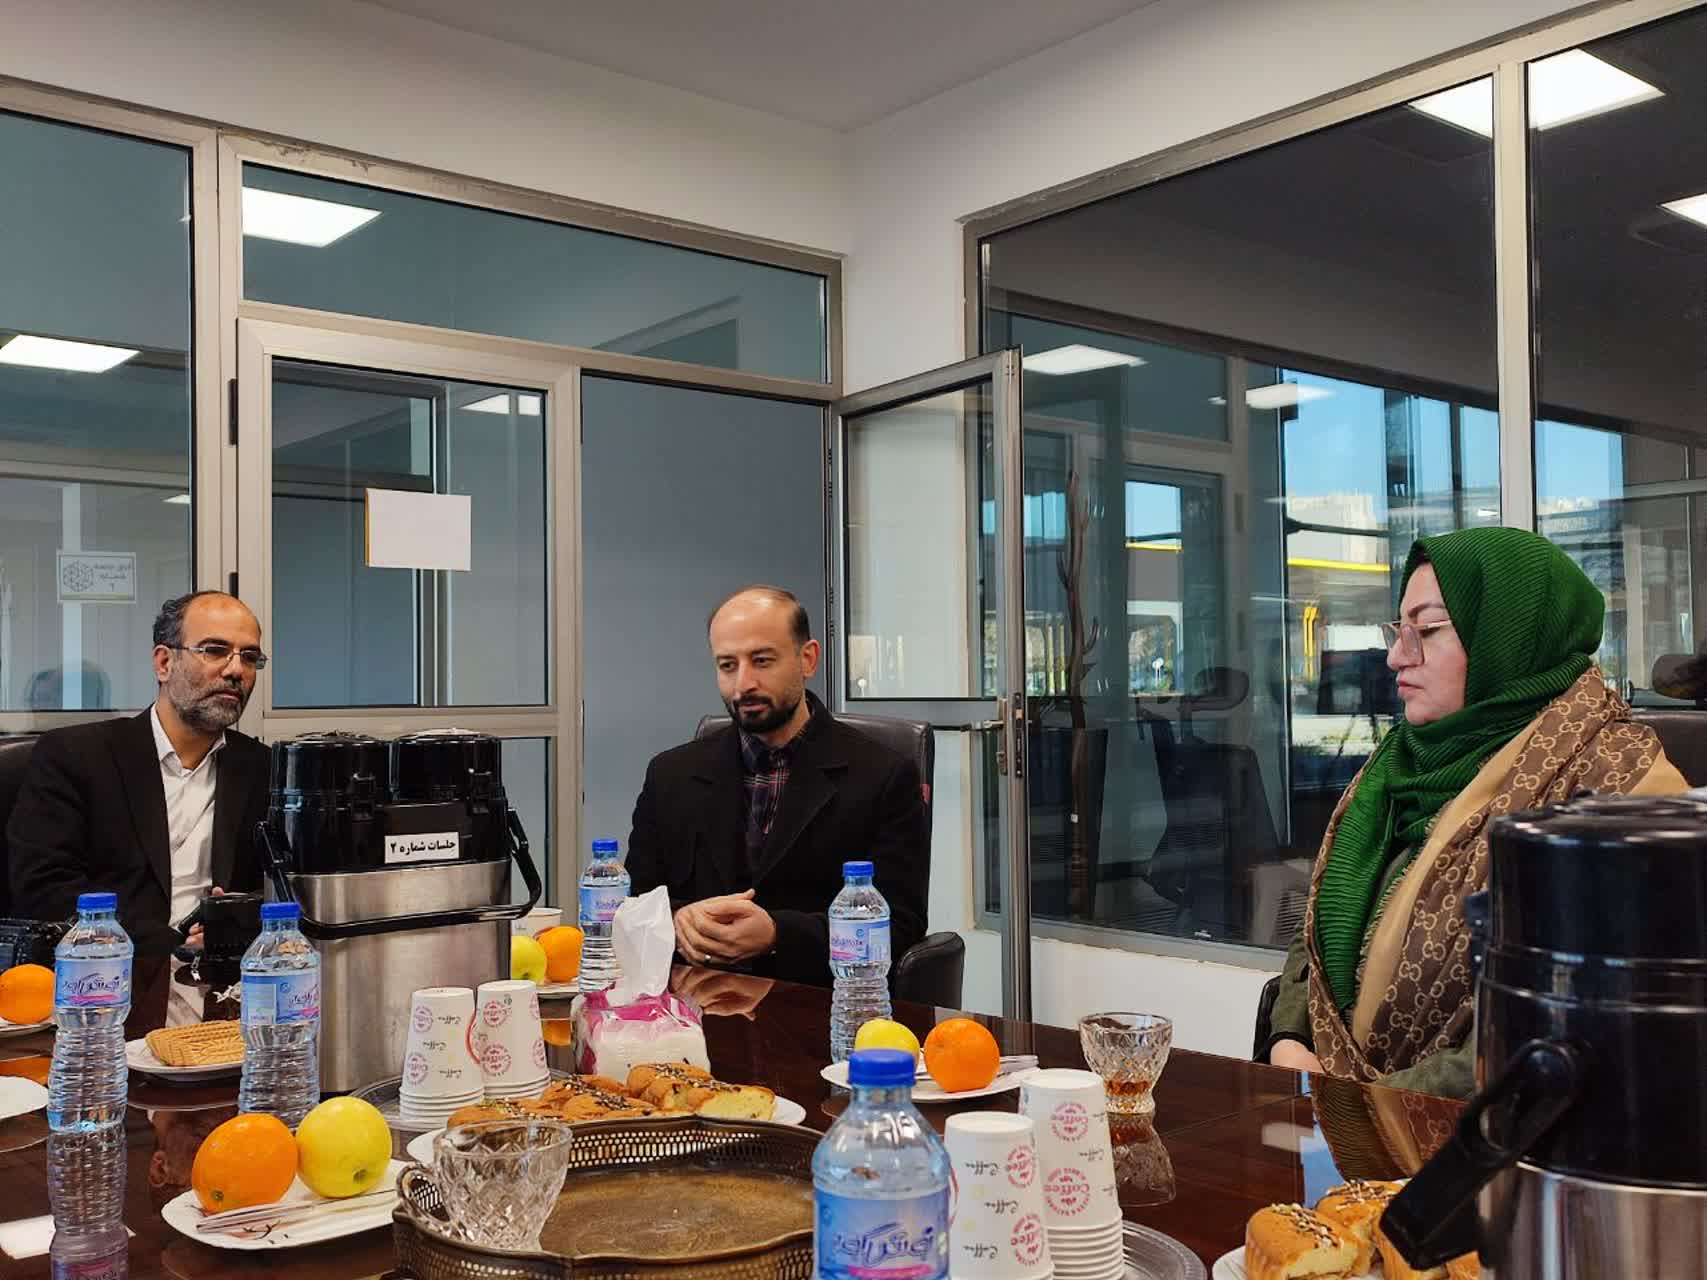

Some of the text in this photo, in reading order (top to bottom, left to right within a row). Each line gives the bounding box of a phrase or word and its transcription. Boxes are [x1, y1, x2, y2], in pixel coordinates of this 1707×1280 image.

[399, 840, 426, 856] شماره
[428, 839, 457, 852] جلسات
[1050, 1114, 1089, 1125] Coffee
[965, 1161, 1000, 1176] Coffee
[1042, 1183, 1091, 1195] Coffee
[984, 1199, 1019, 1214] Coffee
[963, 1243, 998, 1259] Coffee
